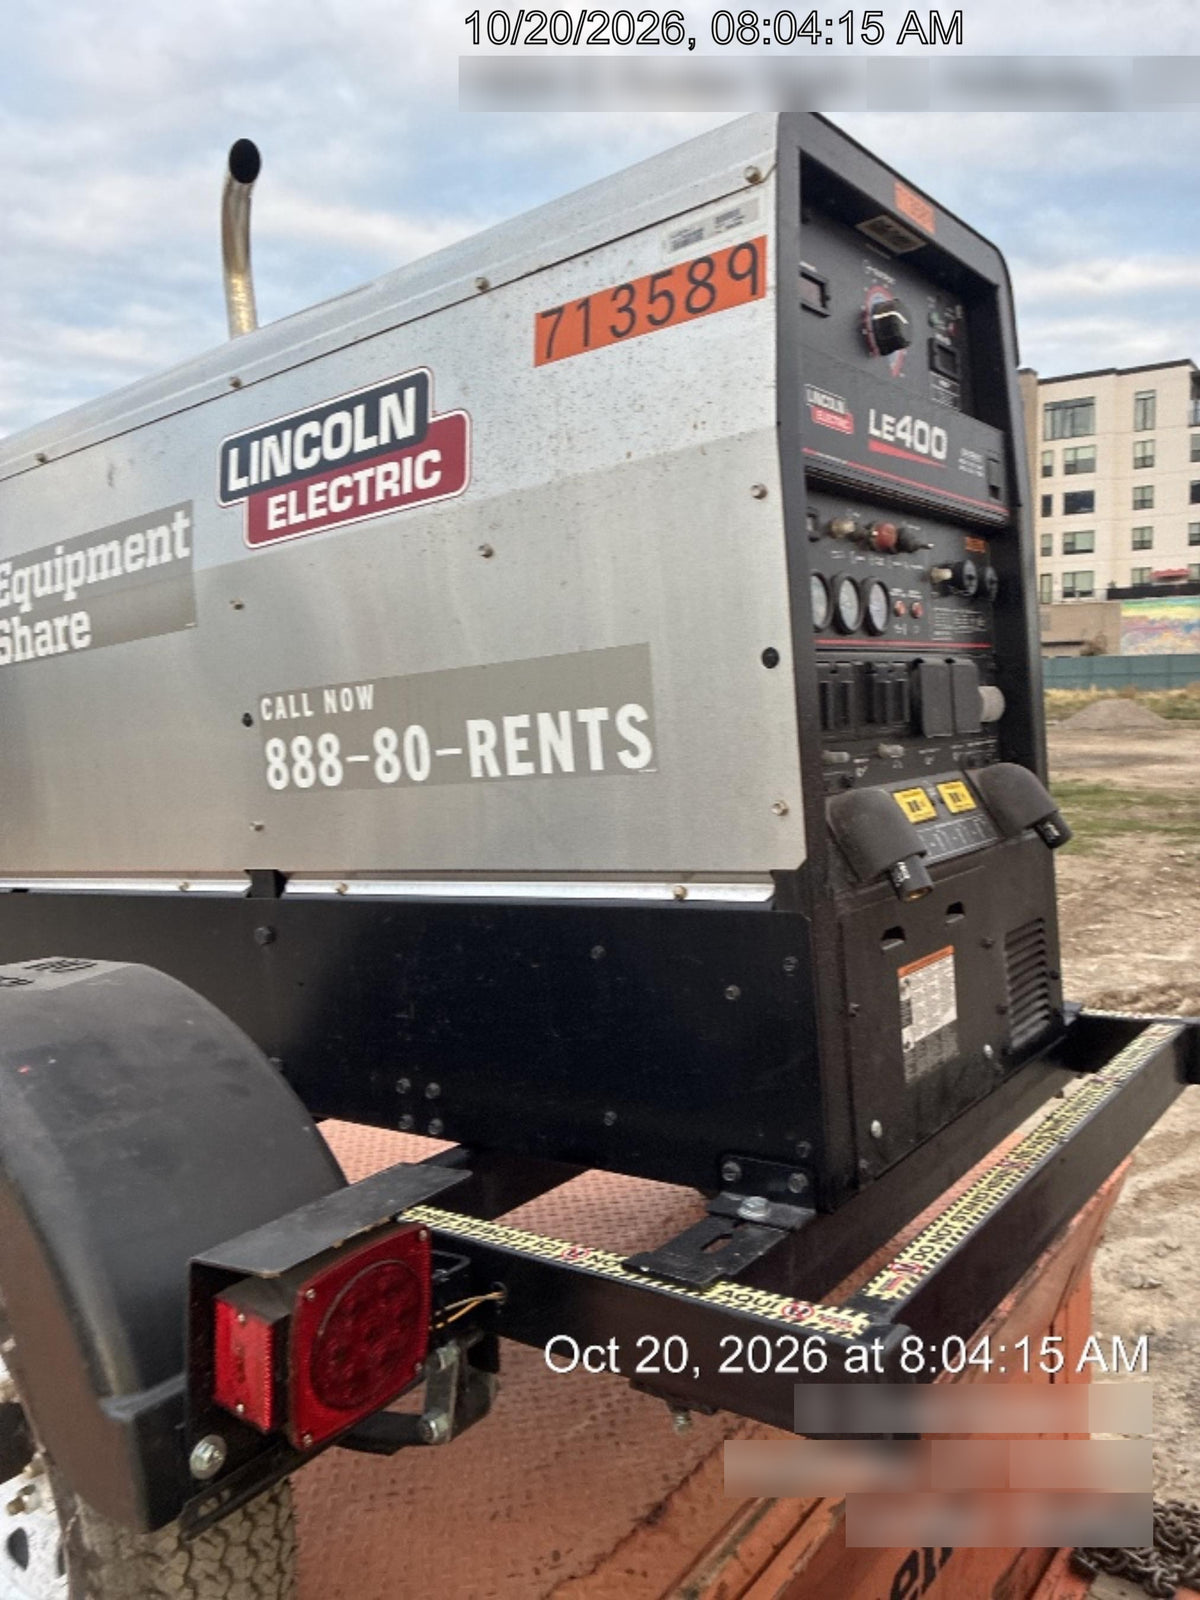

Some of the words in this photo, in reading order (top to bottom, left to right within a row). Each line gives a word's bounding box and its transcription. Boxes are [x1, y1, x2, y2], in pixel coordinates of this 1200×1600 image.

[540, 241, 759, 359] 713589
[227, 386, 416, 492] LINCOLN
[868, 408, 948, 459] LE400
[267, 449, 442, 531] ELECTRIC
[260, 692, 314, 721] CALL
[322, 684, 374, 713] NOW
[265, 702, 653, 790] 888-80-RENTS
